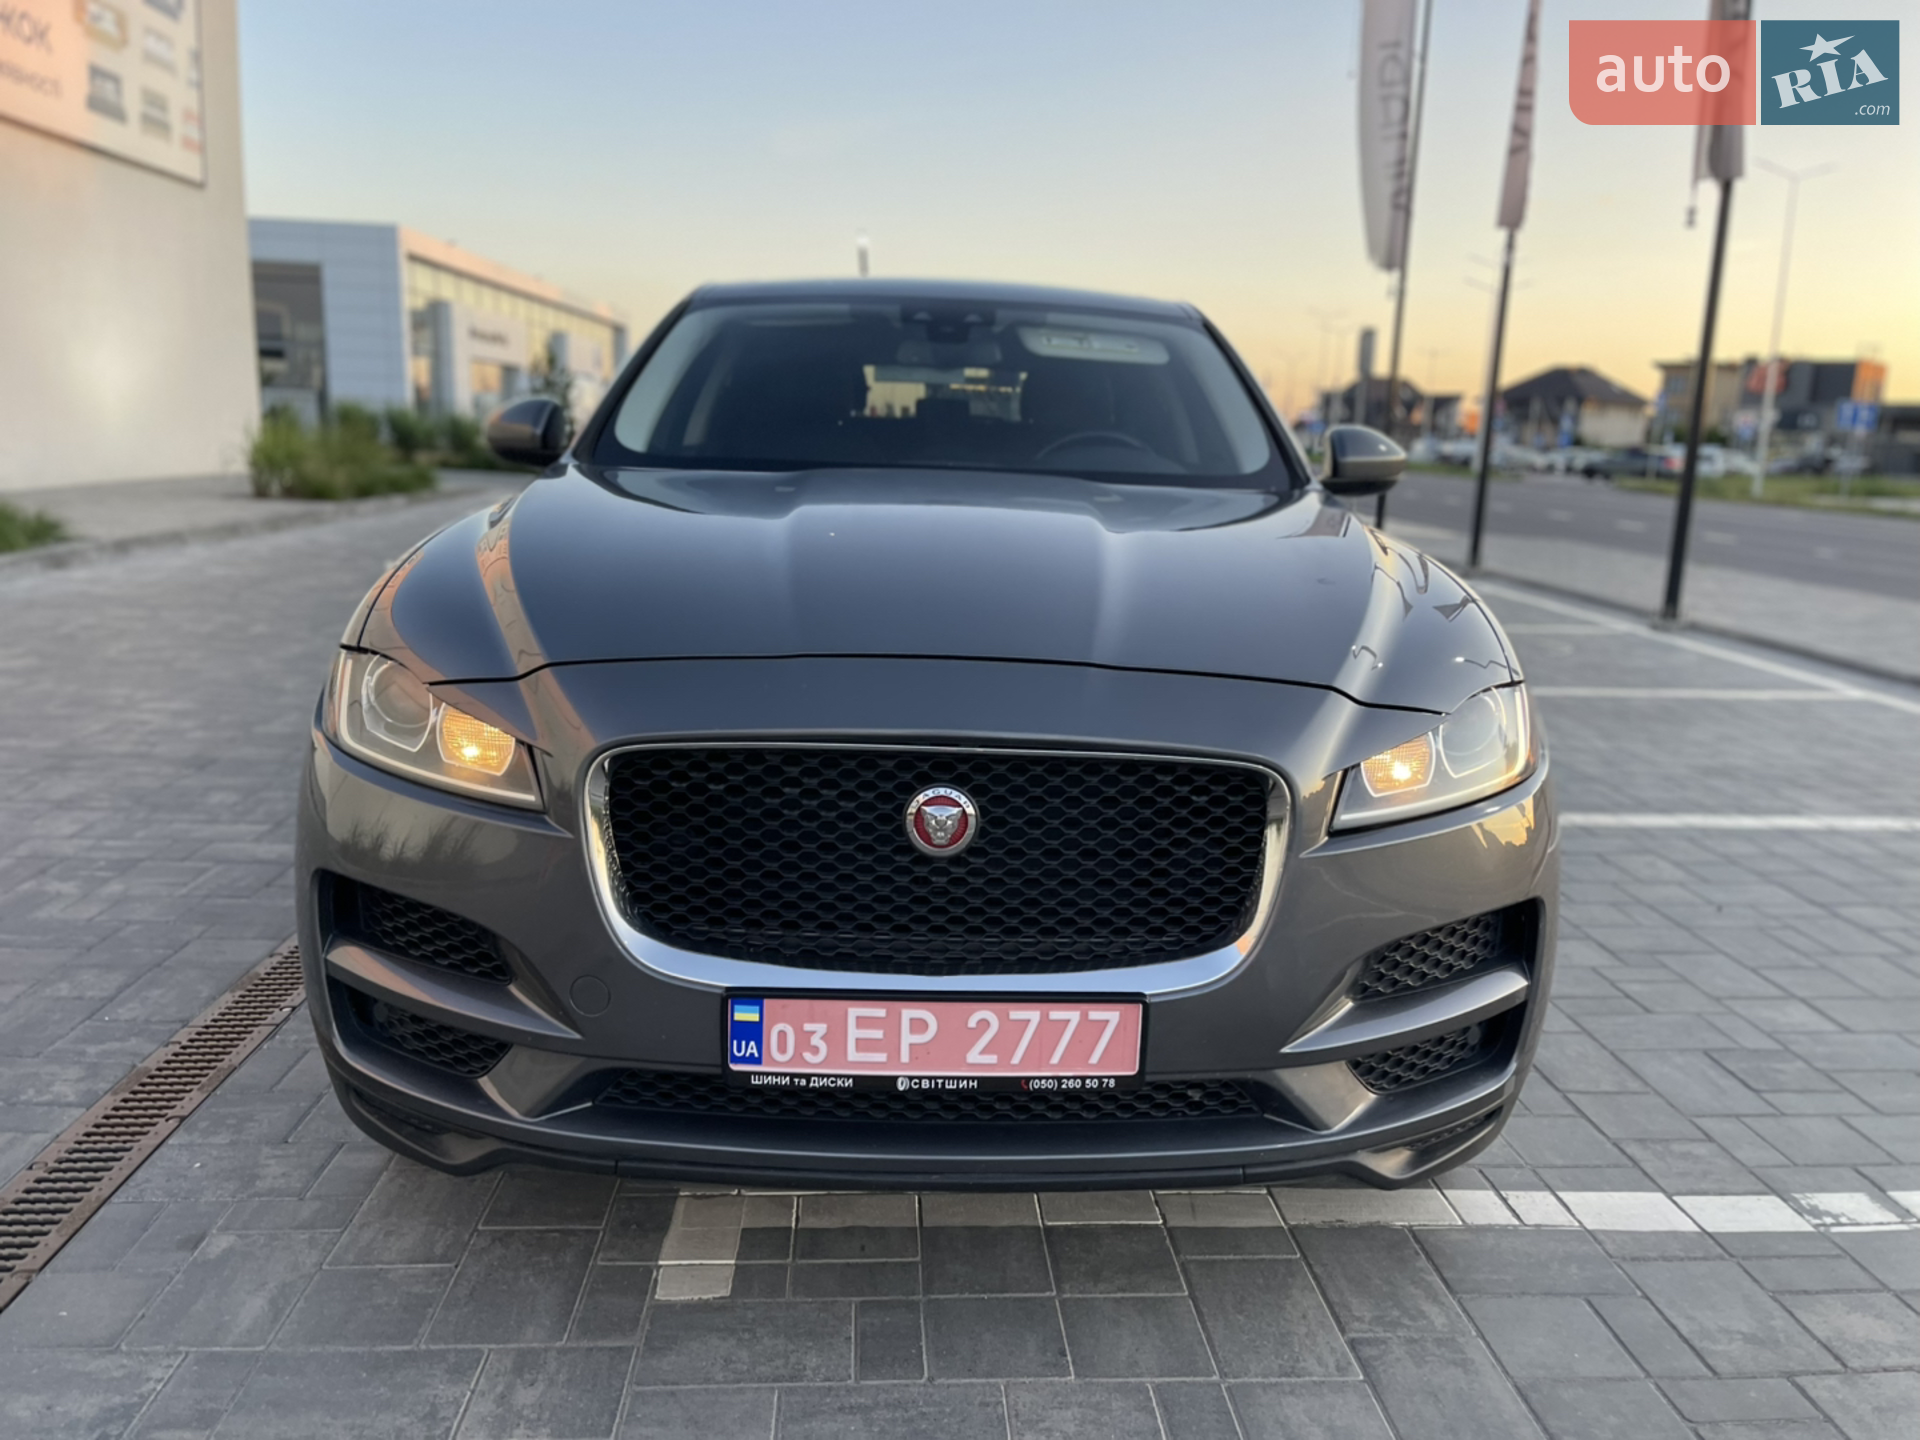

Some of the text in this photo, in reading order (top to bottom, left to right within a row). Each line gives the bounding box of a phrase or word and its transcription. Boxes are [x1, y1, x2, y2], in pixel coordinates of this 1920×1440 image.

[911, 788, 971, 810] JAGUAR
[769, 1007, 1121, 1065] 03 EP 2777
[732, 1040, 759, 1058] UA
[750, 1074, 854, 1088] ШИНИ та ДИСКИ
[911, 1078, 978, 1089] СВІТШИН
[1028, 1077, 1116, 1090] (050) 260 50 78
